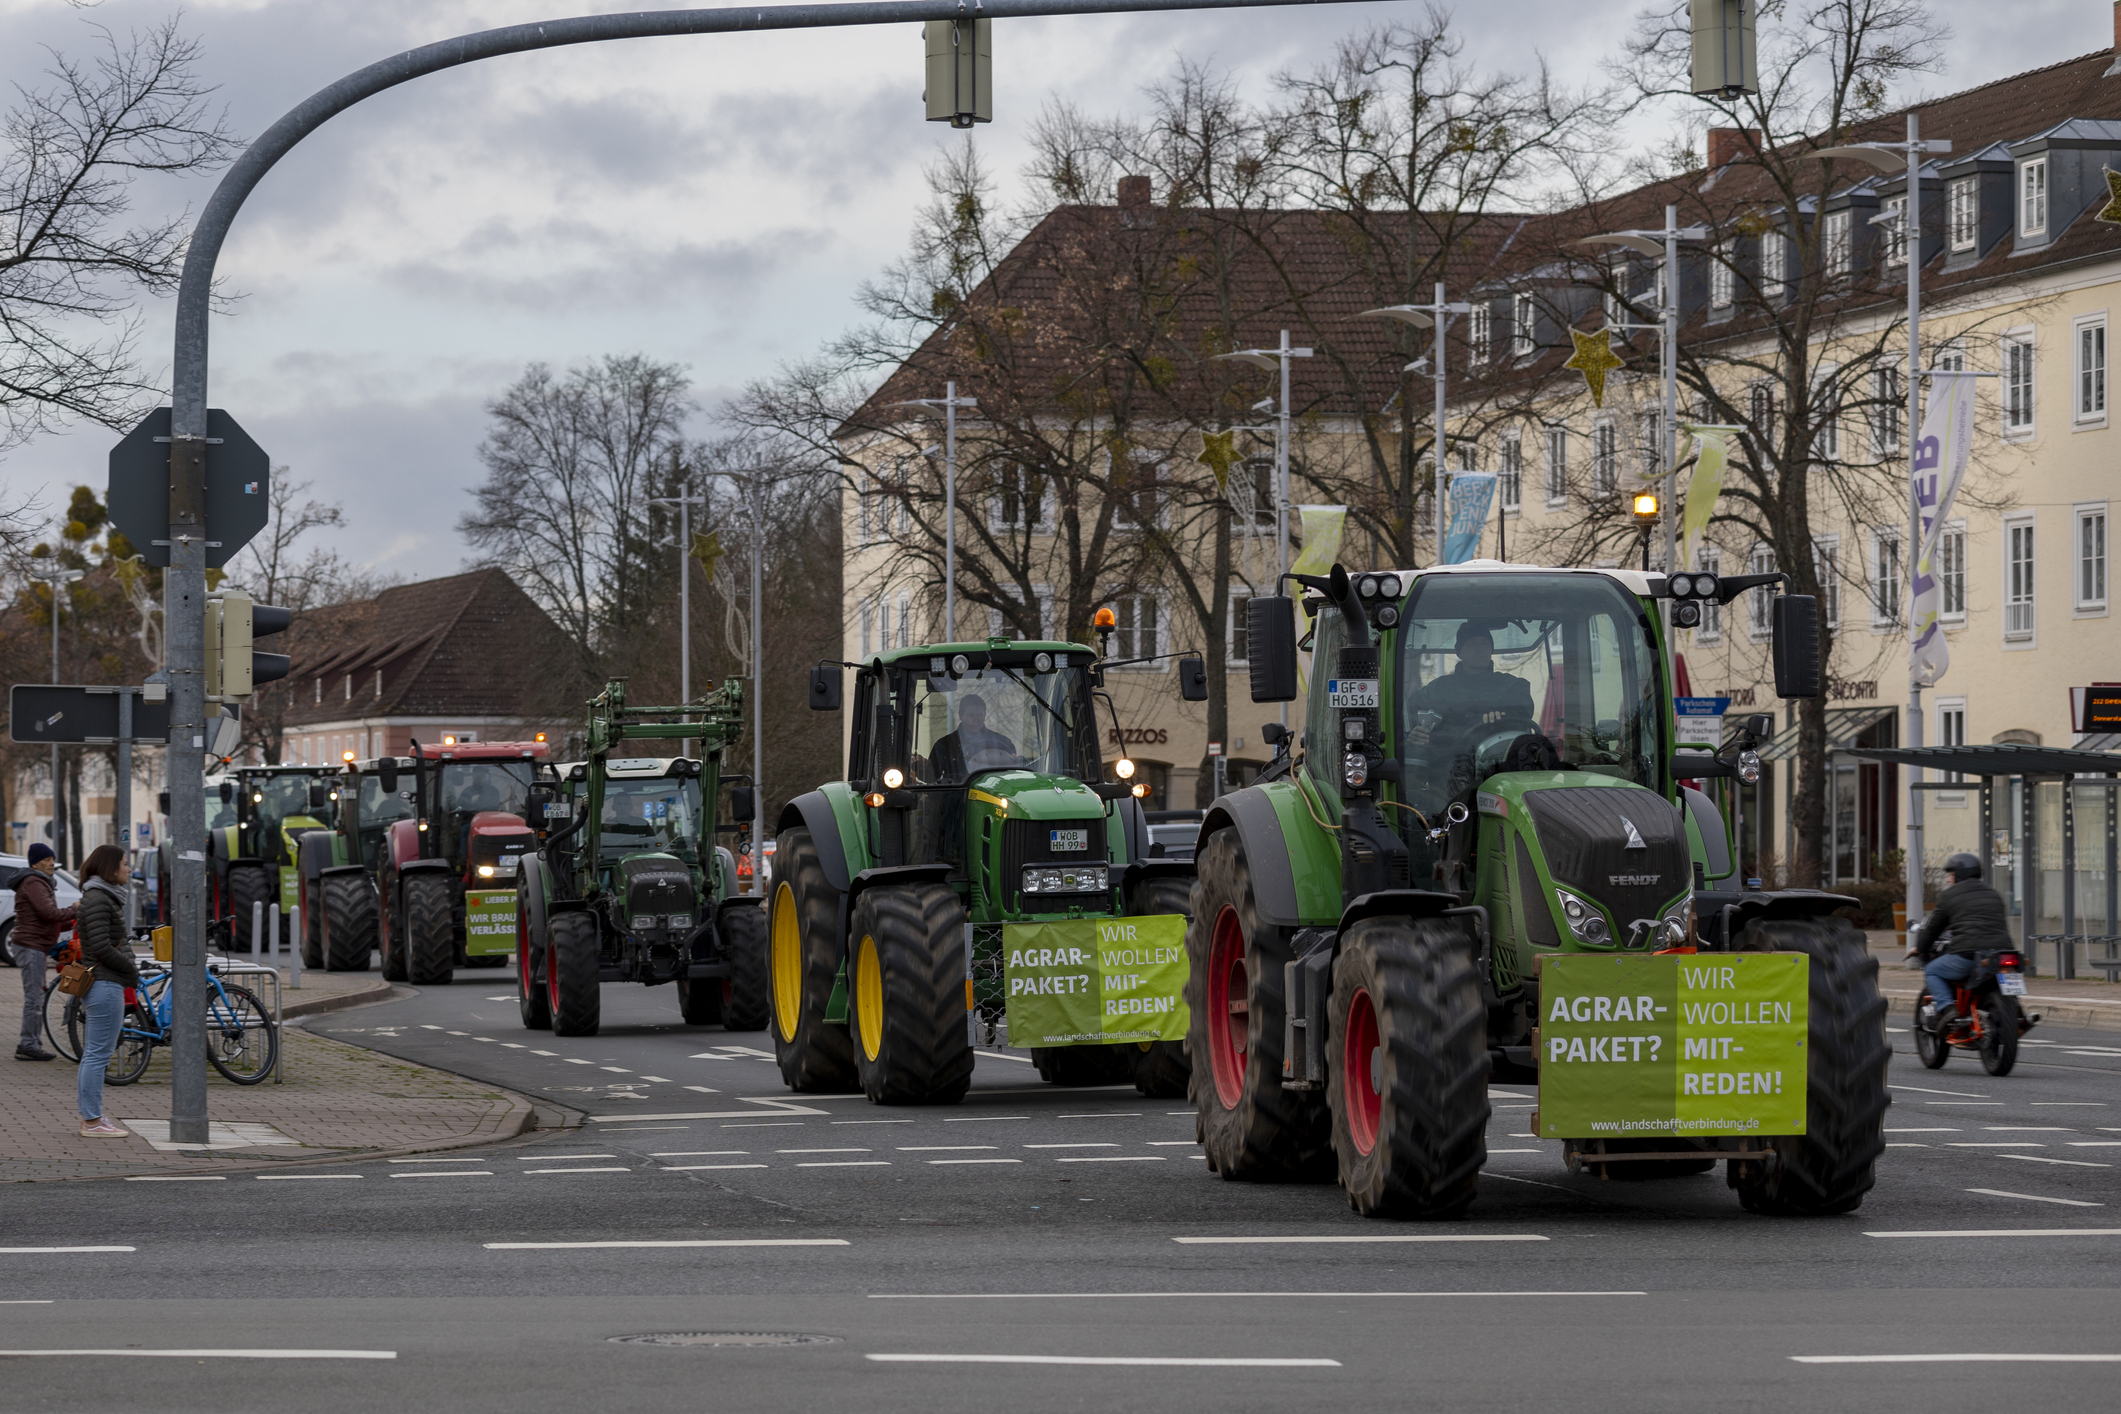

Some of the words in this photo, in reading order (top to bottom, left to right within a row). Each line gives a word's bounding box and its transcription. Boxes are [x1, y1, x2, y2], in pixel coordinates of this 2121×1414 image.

[1460, 506, 1487, 523] END
[1341, 682, 1357, 693] GF
[1332, 695, 1348, 706] HO
[1351, 695, 1374, 706] 516
[1109, 728, 1168, 744] RIZZOS
[1060, 832, 1078, 840] WOB
[1052, 841, 1065, 850] HH
[1067, 841, 1079, 850] 99
[1608, 874, 1661, 886] FENDT
[485, 896, 509, 904] LIEBER
[470, 914, 489, 923] WIR
[1101, 925, 1138, 942] WIR
[1009, 948, 1091, 968] AGRAR-
[1102, 947, 1179, 967] WOLLEN
[1011, 975, 1089, 996] PAKET?
[1105, 974, 1147, 991] MIT-
[1684, 967, 1735, 989] WIR
[1106, 996, 1175, 1016] REDEN!
[1549, 996, 1668, 1022] AGRAR-
[1683, 1001, 1791, 1025] WOLLEN
[1043, 1029, 1161, 1042] www.landschafftverbindung.de
[1550, 1035, 1662, 1063] PAKET?
[1684, 1037, 1744, 1060] MIT-
[1684, 1071, 1782, 1095] REDEN!
[1591, 1118, 1760, 1132] www.landschafftverbindung.de
